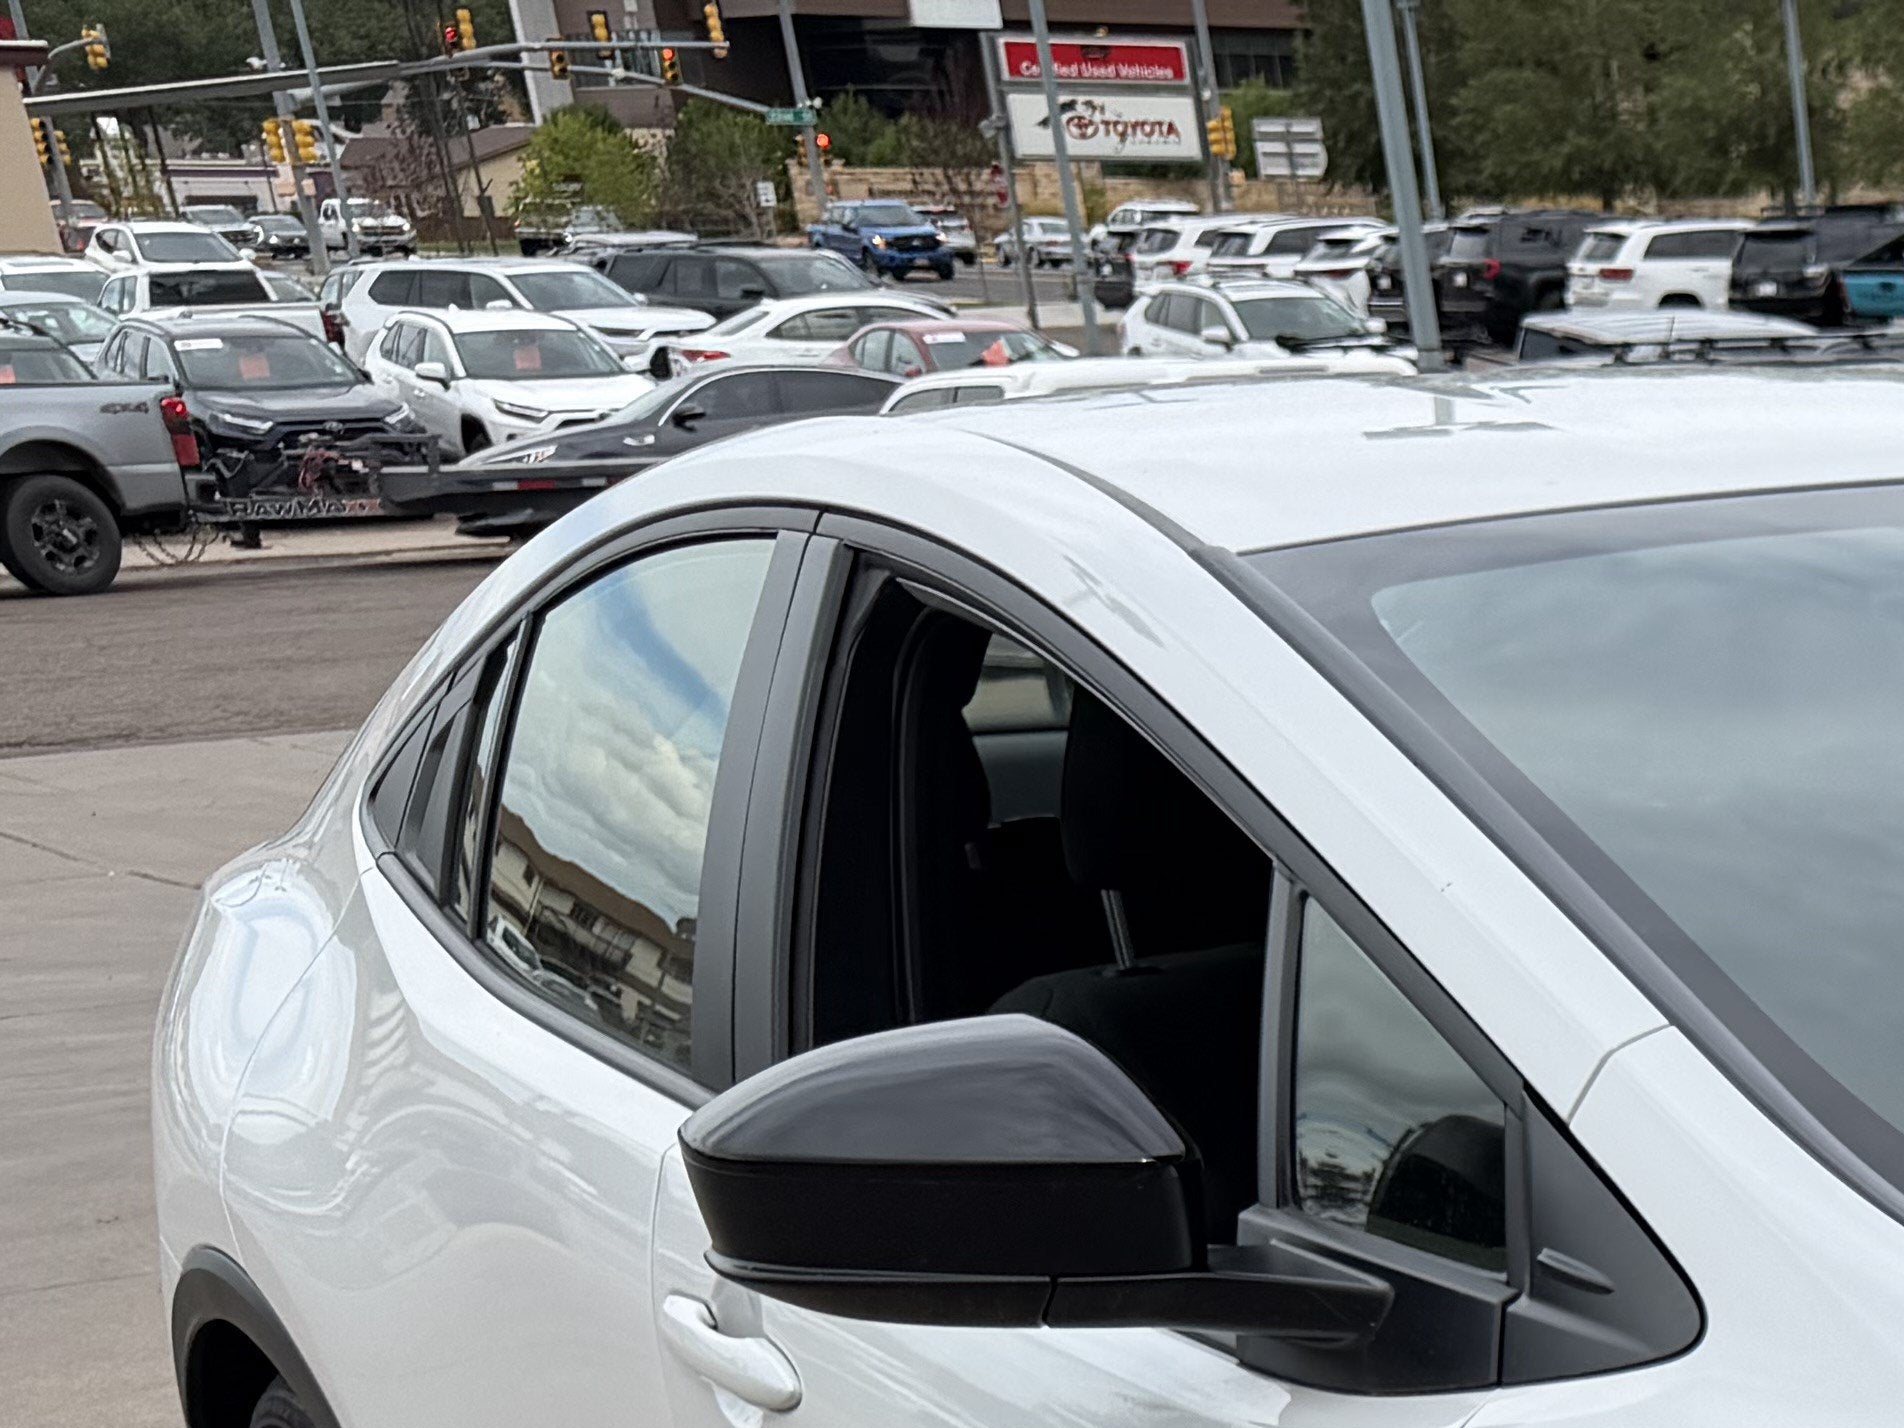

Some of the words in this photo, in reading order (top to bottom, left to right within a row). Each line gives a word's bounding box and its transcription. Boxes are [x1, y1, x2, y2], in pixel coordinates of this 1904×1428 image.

[1080, 61, 1116, 78] Used
[1117, 62, 1174, 79] Vehicles
[1100, 119, 1181, 139] TOYOTA
